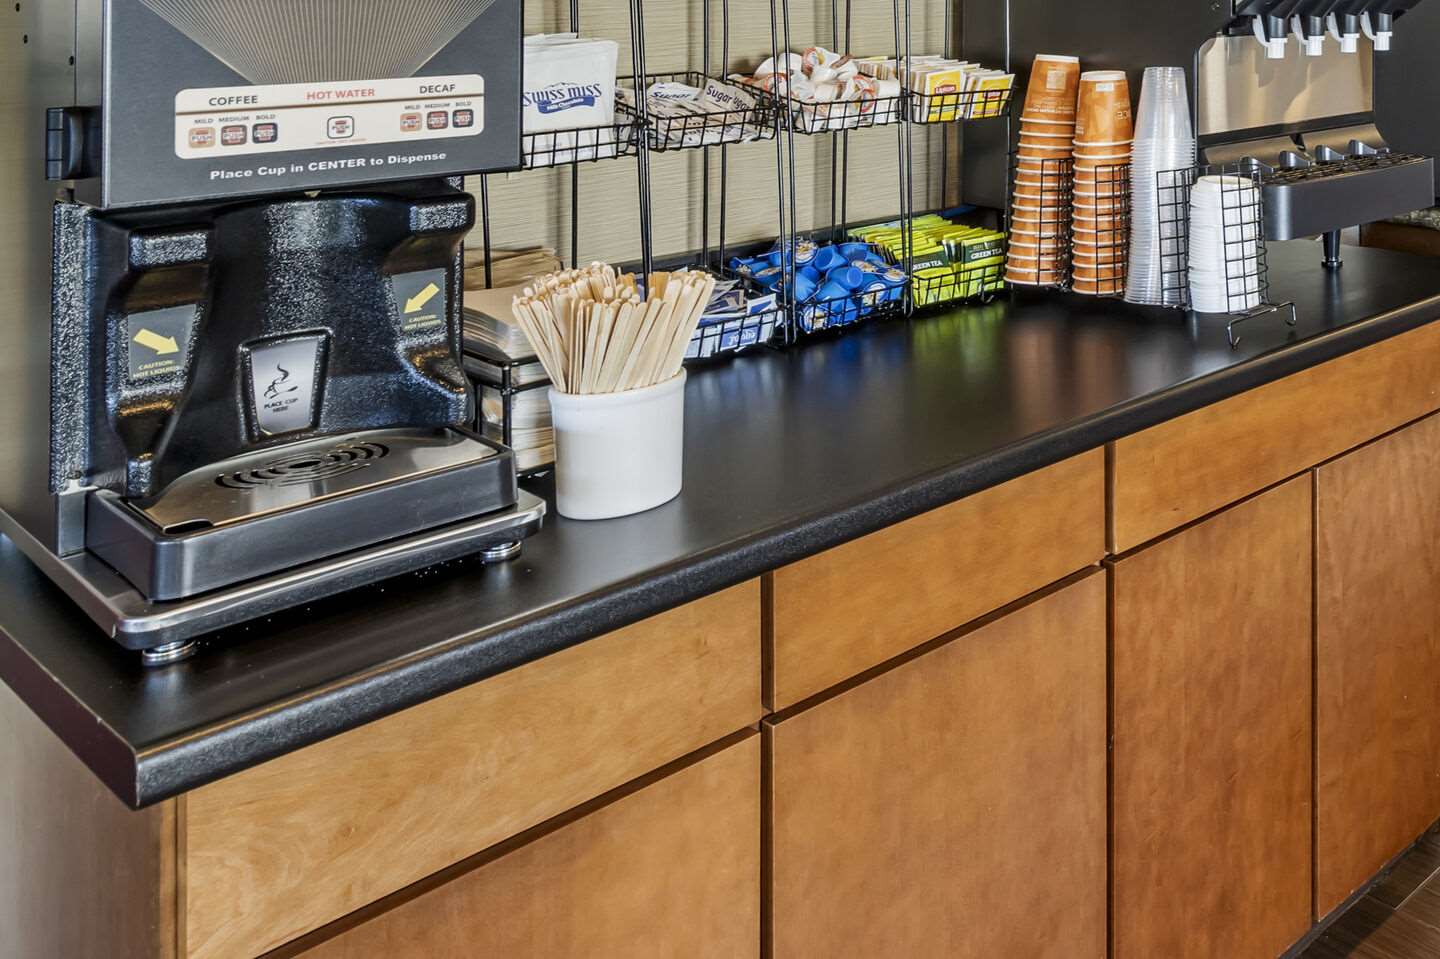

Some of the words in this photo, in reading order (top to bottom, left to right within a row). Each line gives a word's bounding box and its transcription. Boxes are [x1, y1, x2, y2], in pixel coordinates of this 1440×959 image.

[208, 95, 259, 107] COFFEE
[306, 90, 332, 100] HOT
[335, 88, 375, 99] WATER
[419, 84, 456, 94] DECAF
[706, 84, 733, 104] Sugar
[209, 169, 253, 180] Place
[257, 166, 286, 177] Cup
[290, 163, 304, 173] in
[308, 158, 366, 171] CENTER
[370, 157, 384, 166] to
[388, 152, 447, 166] Dispense
[931, 258, 943, 267] TEA
[970, 250, 992, 260] GREEN
[992, 247, 1003, 256] TEA
